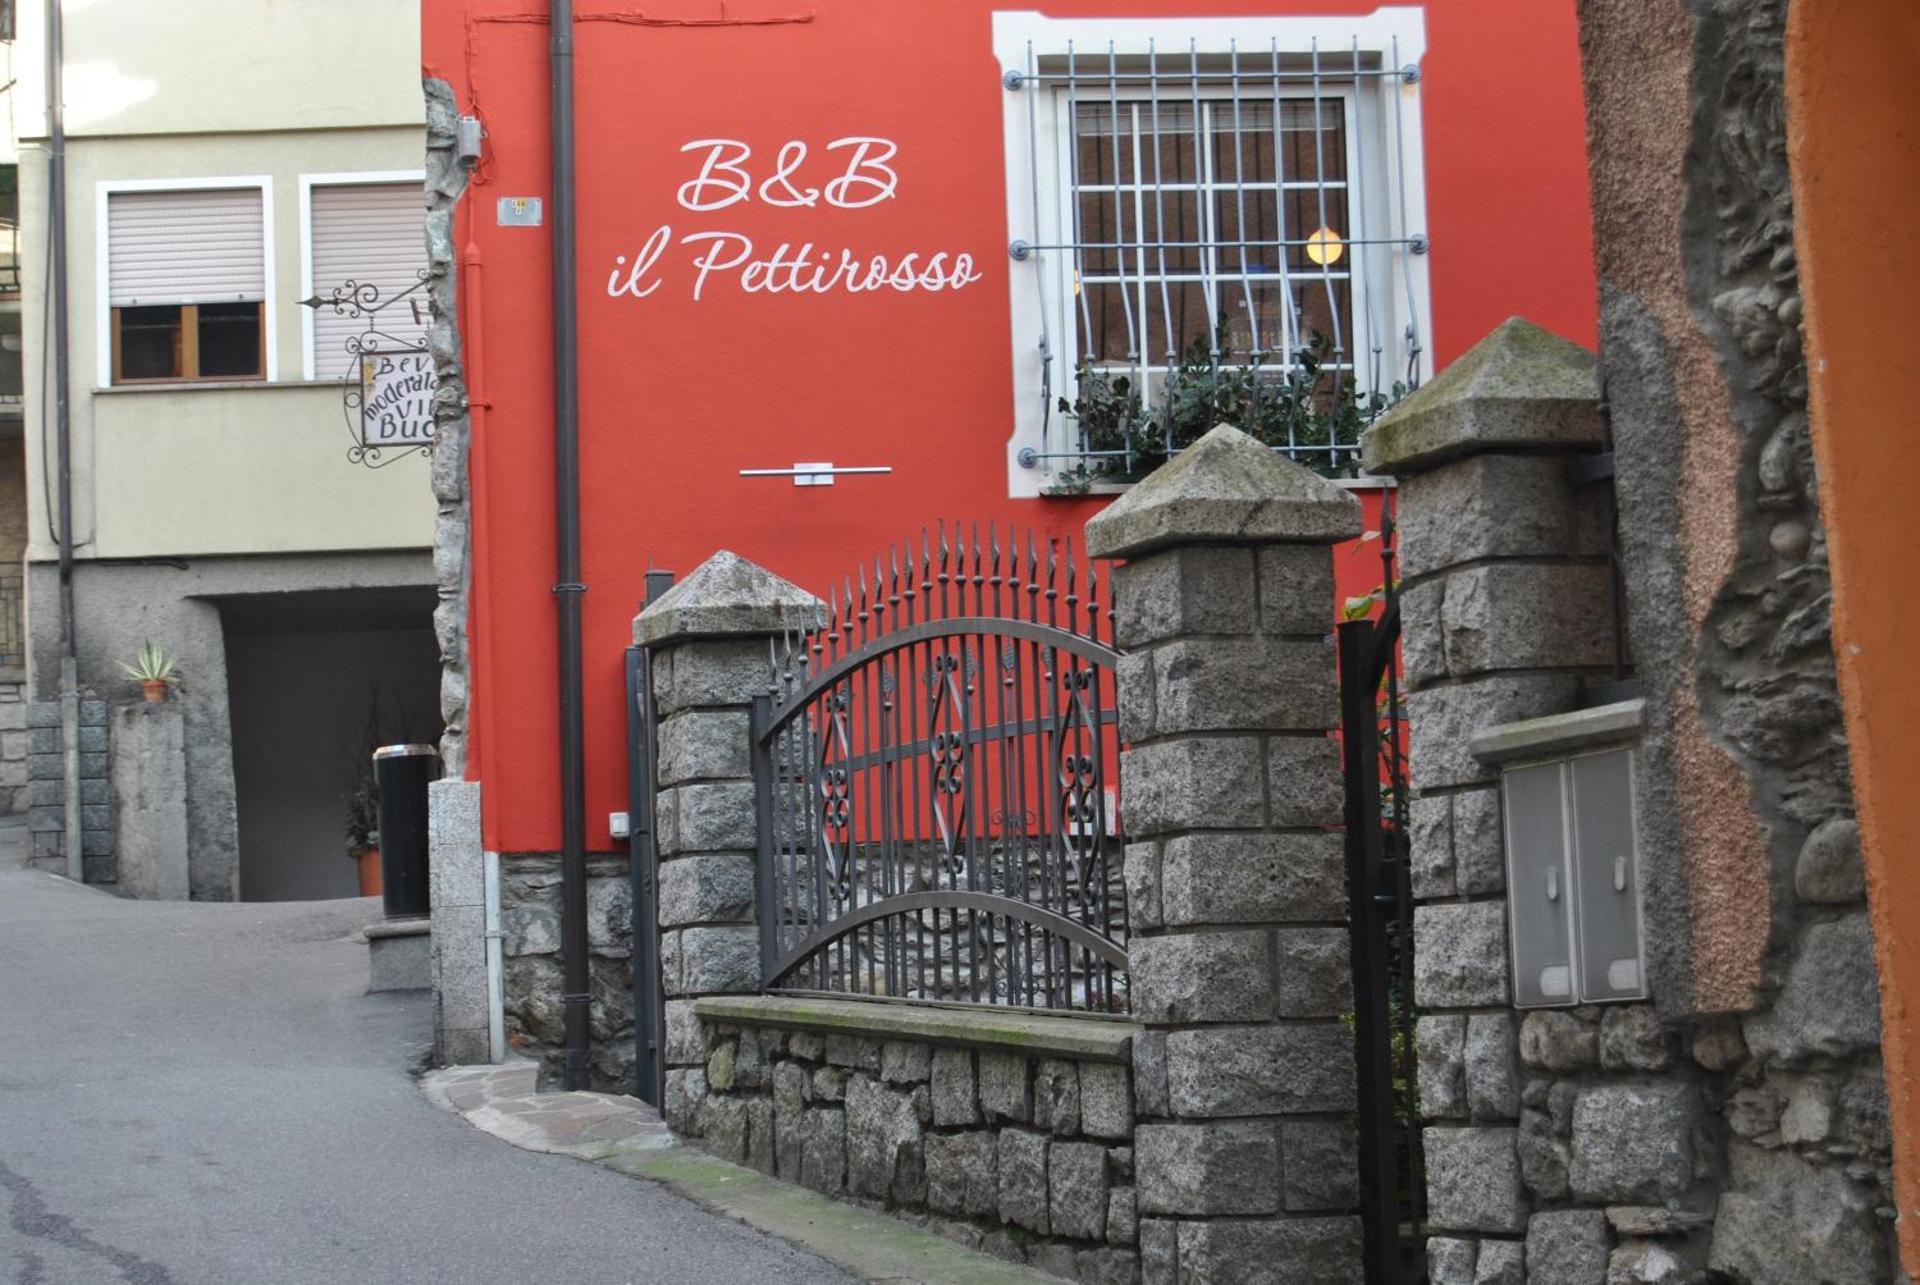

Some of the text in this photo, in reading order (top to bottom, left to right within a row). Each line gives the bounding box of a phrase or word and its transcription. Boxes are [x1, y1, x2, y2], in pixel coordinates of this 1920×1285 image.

[677, 136, 898, 211] B&B
[607, 225, 982, 301] il Pettirosso
